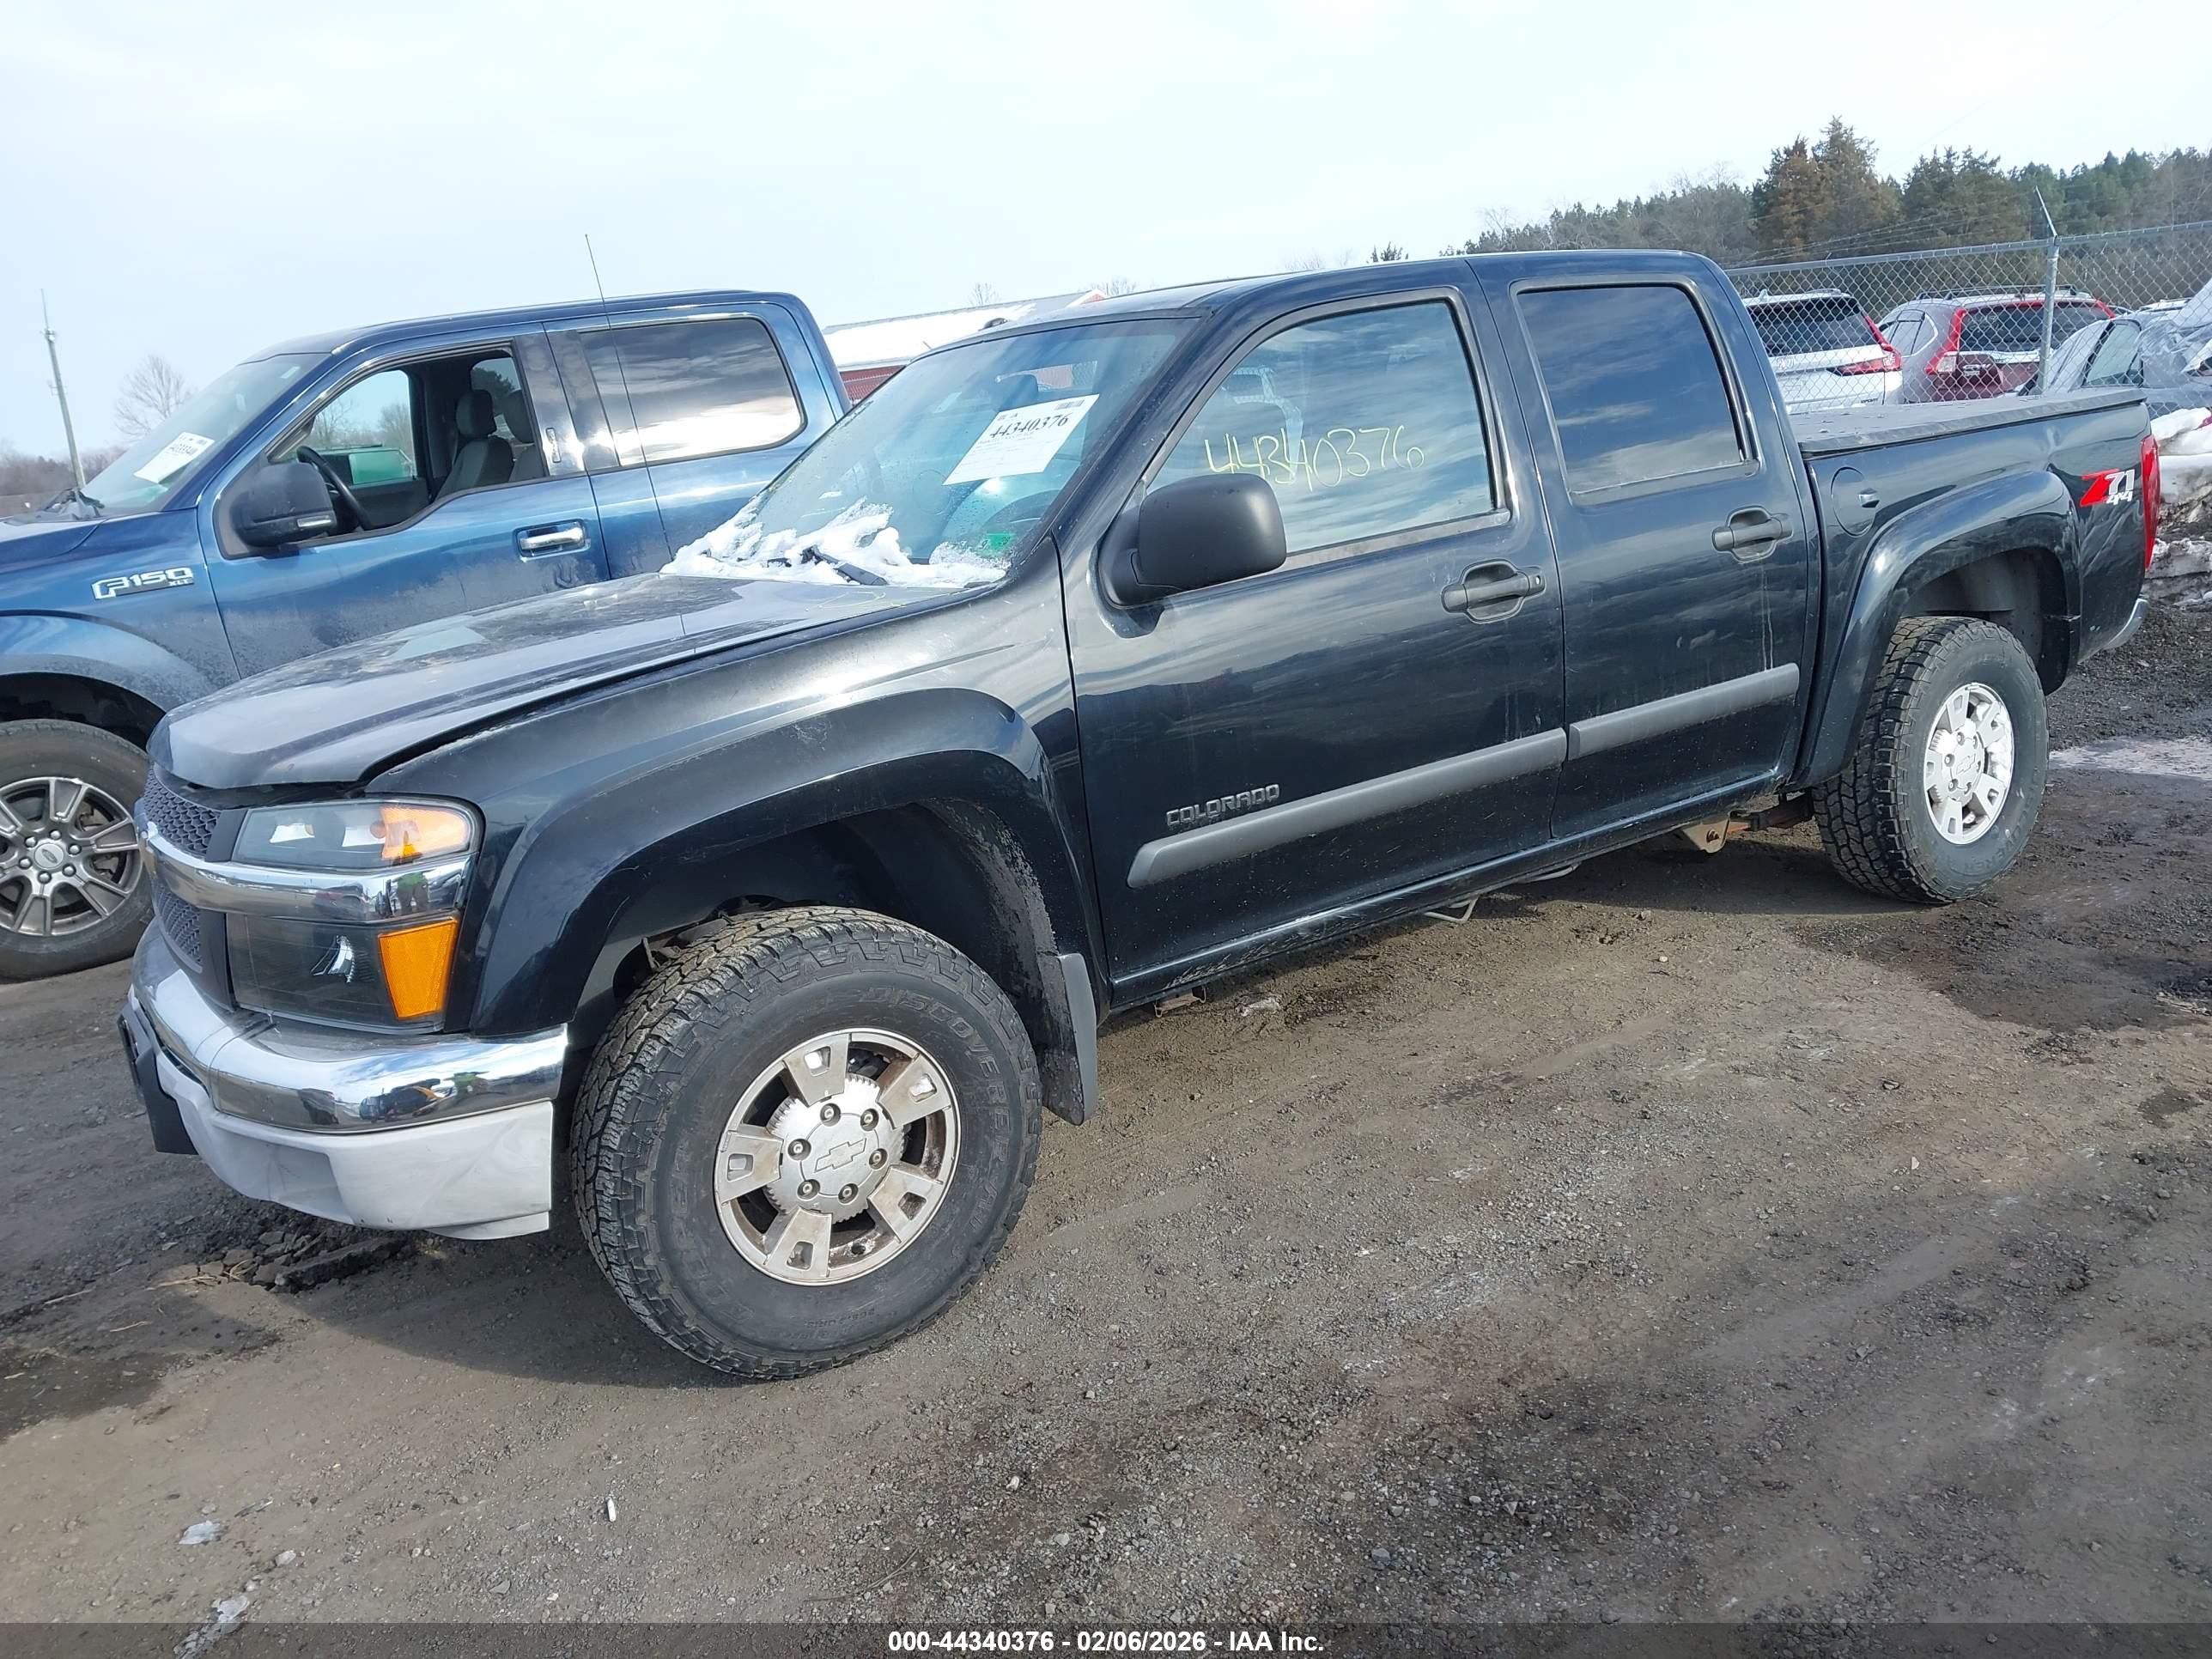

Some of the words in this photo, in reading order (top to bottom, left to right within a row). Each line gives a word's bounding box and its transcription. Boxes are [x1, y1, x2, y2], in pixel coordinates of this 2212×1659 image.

[989, 412, 1073, 439] 44340376
[1204, 425, 1425, 492] 44340376
[2080, 468, 2136, 507] Z71
[1166, 783, 1280, 827] COLORADO
